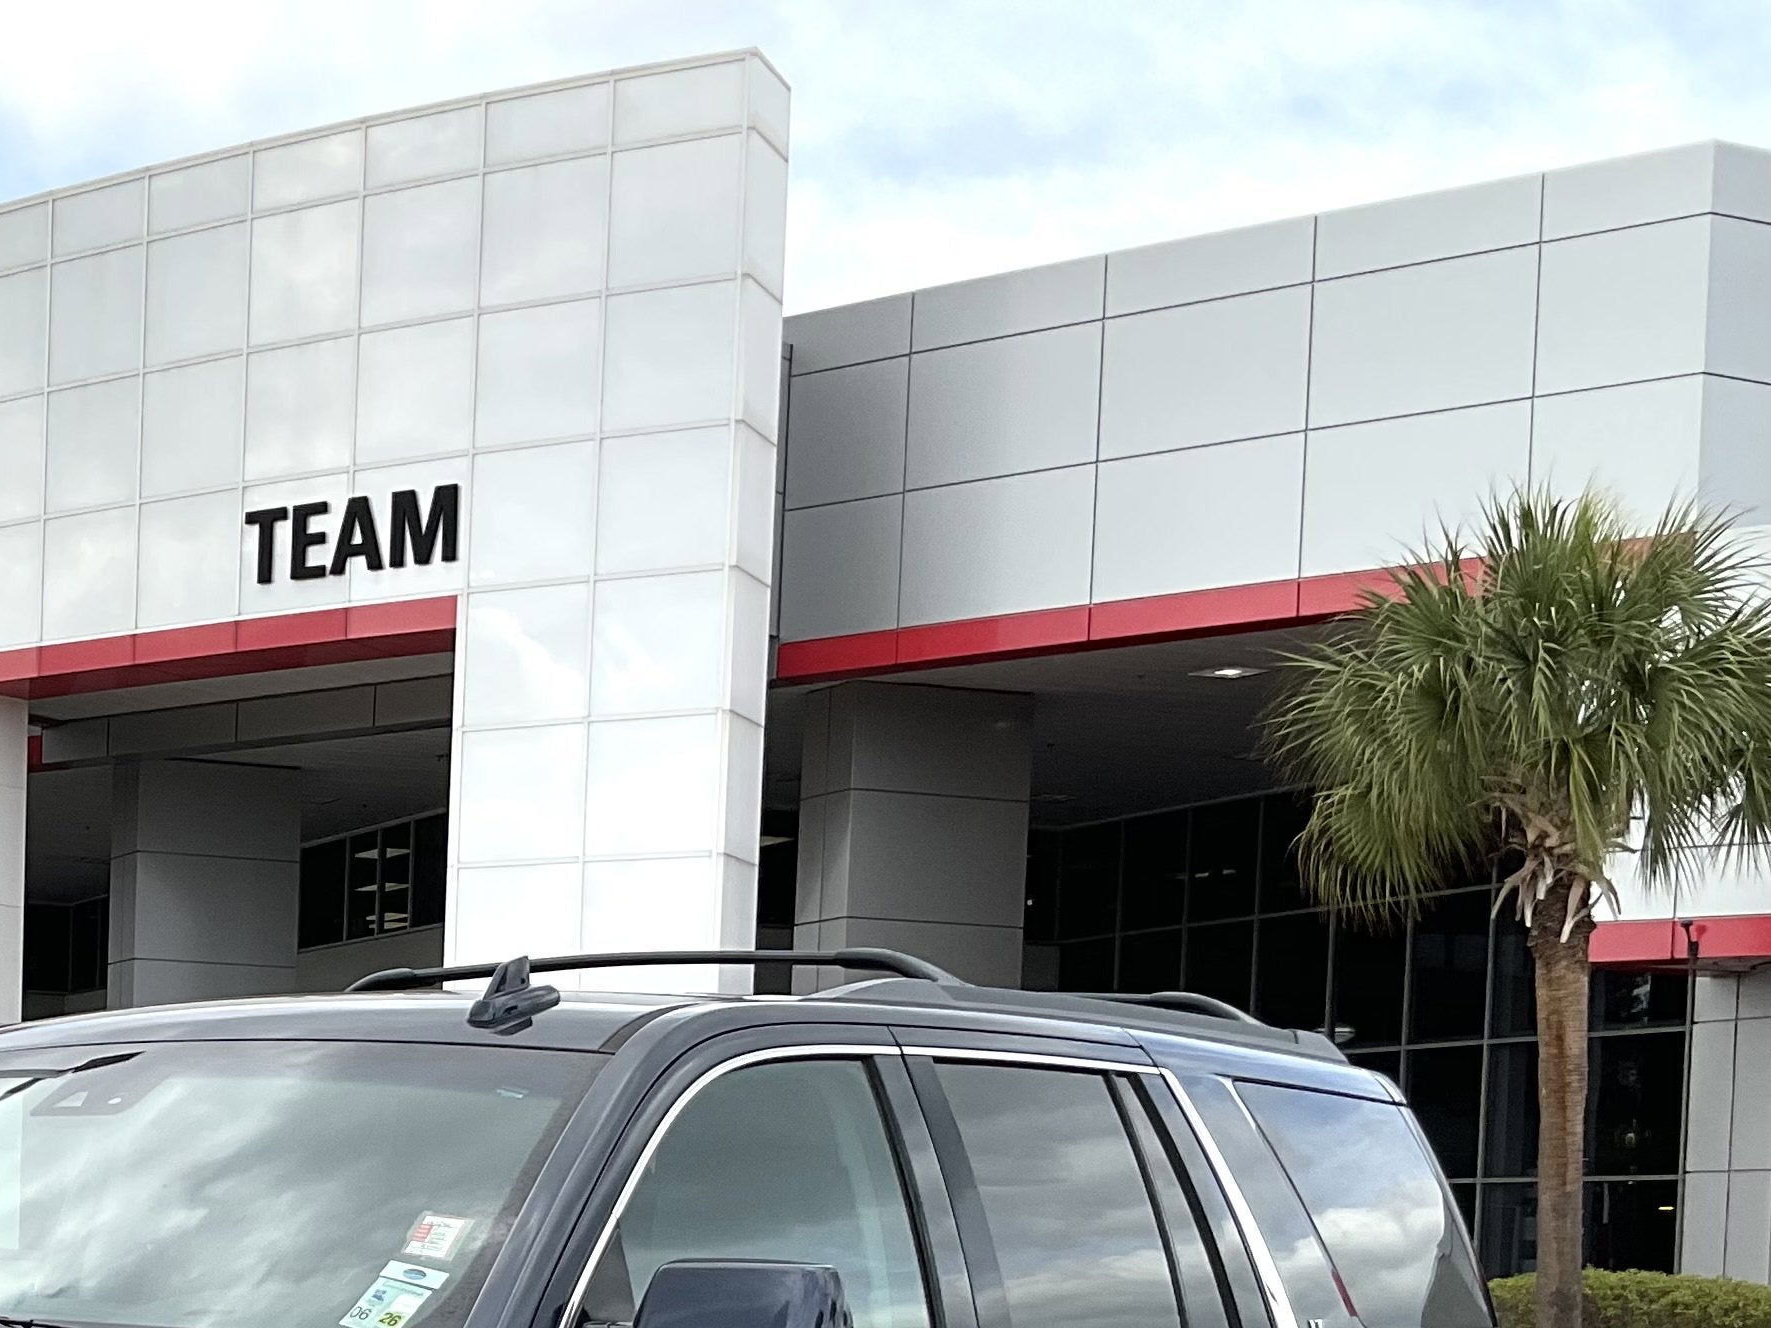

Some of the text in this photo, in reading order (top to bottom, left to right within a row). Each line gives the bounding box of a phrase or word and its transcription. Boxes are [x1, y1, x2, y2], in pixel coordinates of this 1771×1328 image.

[245, 483, 460, 585] TEAM
[349, 1306, 403, 1327] 06 26
